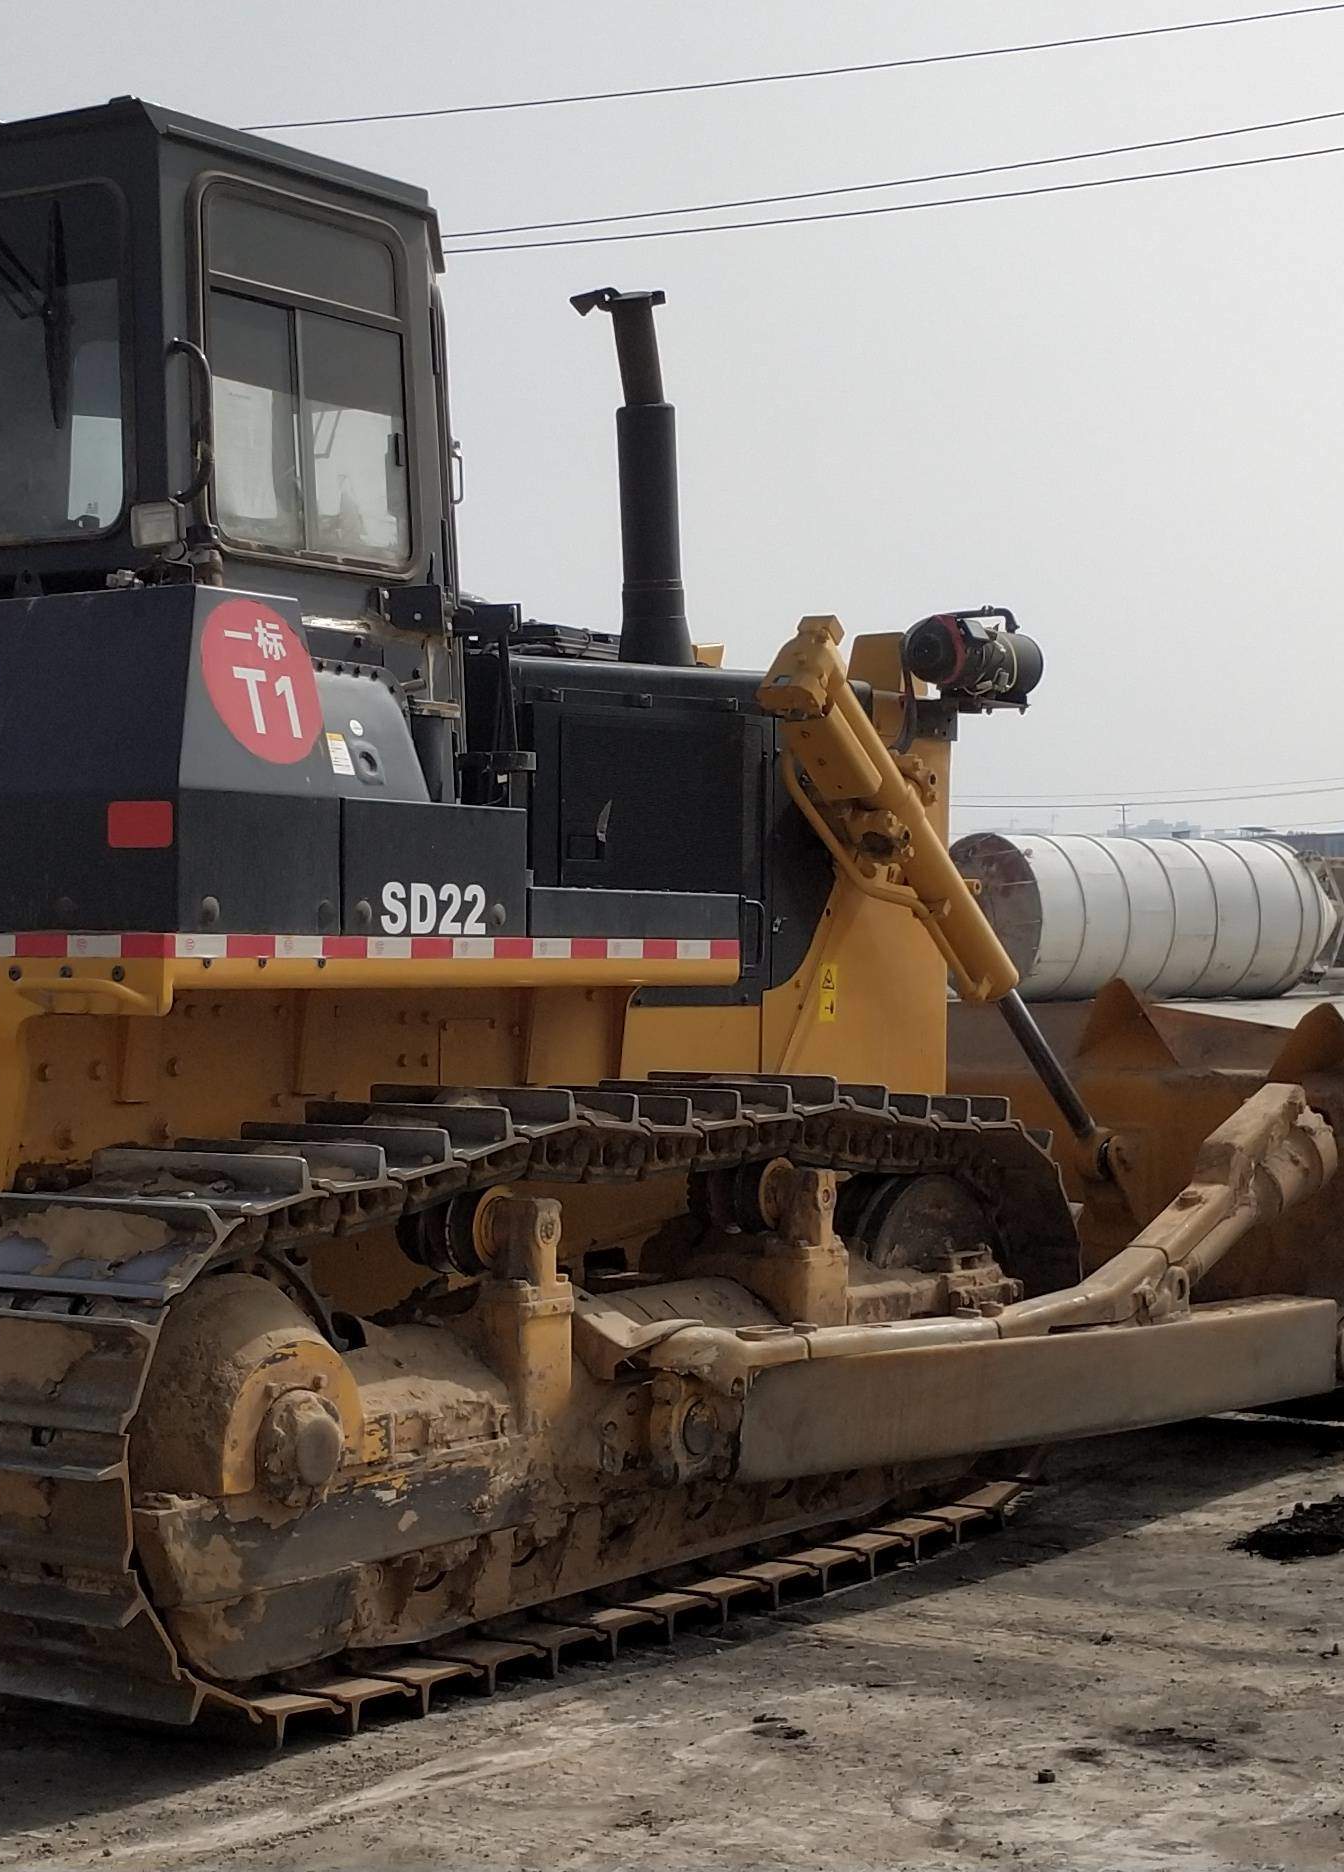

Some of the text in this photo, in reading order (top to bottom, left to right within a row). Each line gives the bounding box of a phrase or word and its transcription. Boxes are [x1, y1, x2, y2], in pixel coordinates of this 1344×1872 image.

[223, 618, 288, 662] 一标
[231, 665, 304, 740] T1
[380, 881, 487, 936] SD22
